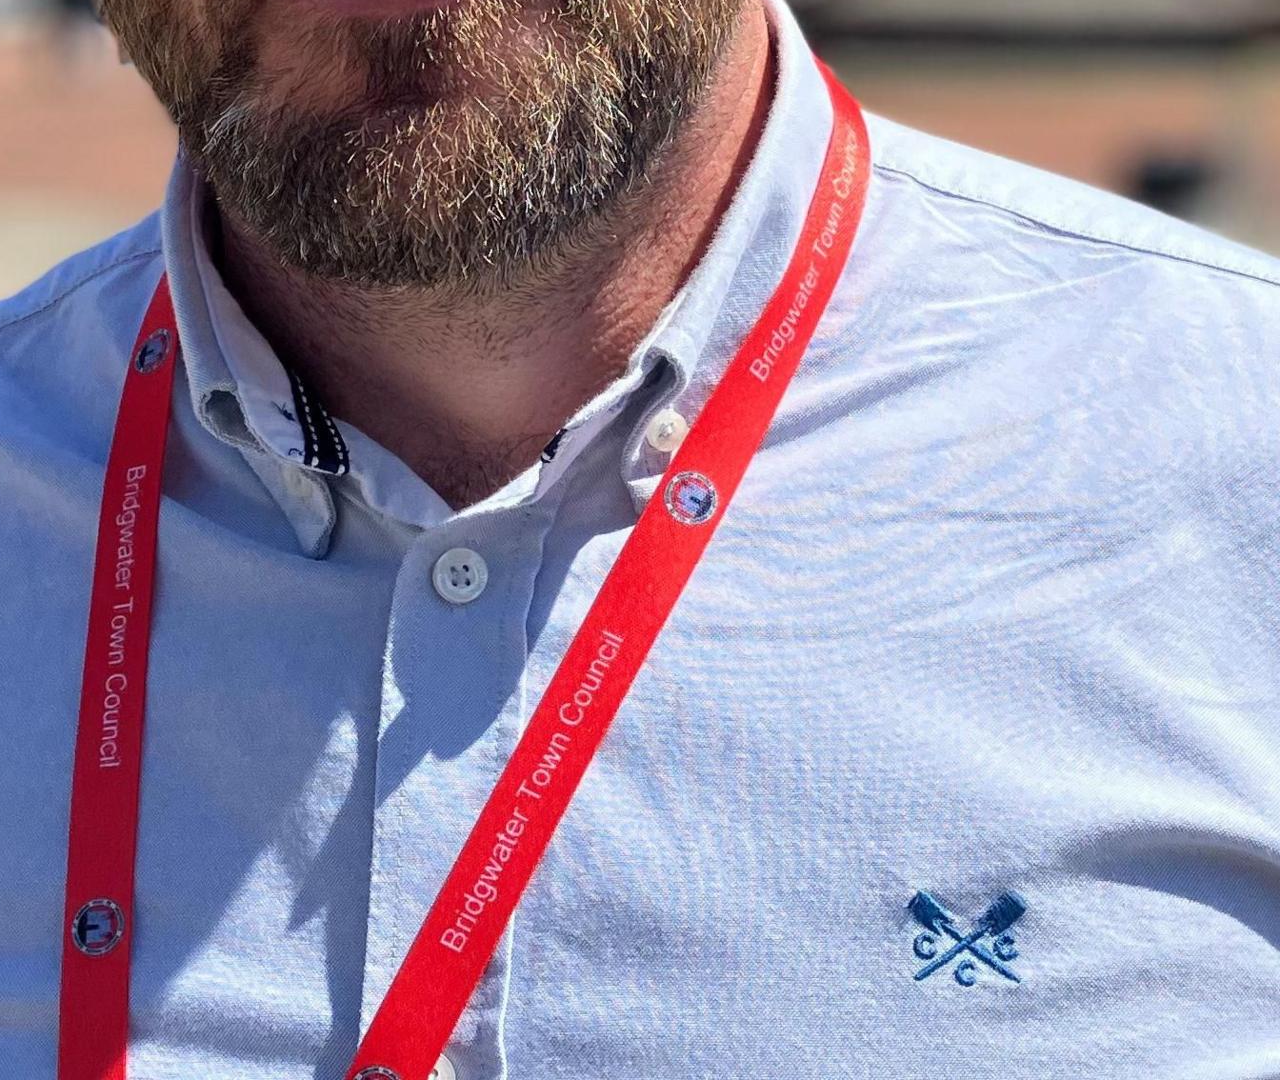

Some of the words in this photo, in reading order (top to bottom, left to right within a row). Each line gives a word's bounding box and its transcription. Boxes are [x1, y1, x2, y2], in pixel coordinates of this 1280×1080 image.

[749, 263, 819, 382] Bridgwater
[812, 203, 844, 260] Town
[114, 465, 146, 591] Bridgwater
[108, 597, 134, 665] Town
[98, 673, 128, 768] Council
[439, 809, 529, 954] Bridgwater
[515, 732, 572, 803] Town
[557, 630, 625, 727] Council
[913, 933, 937, 960] C
[954, 959, 976, 987] C
